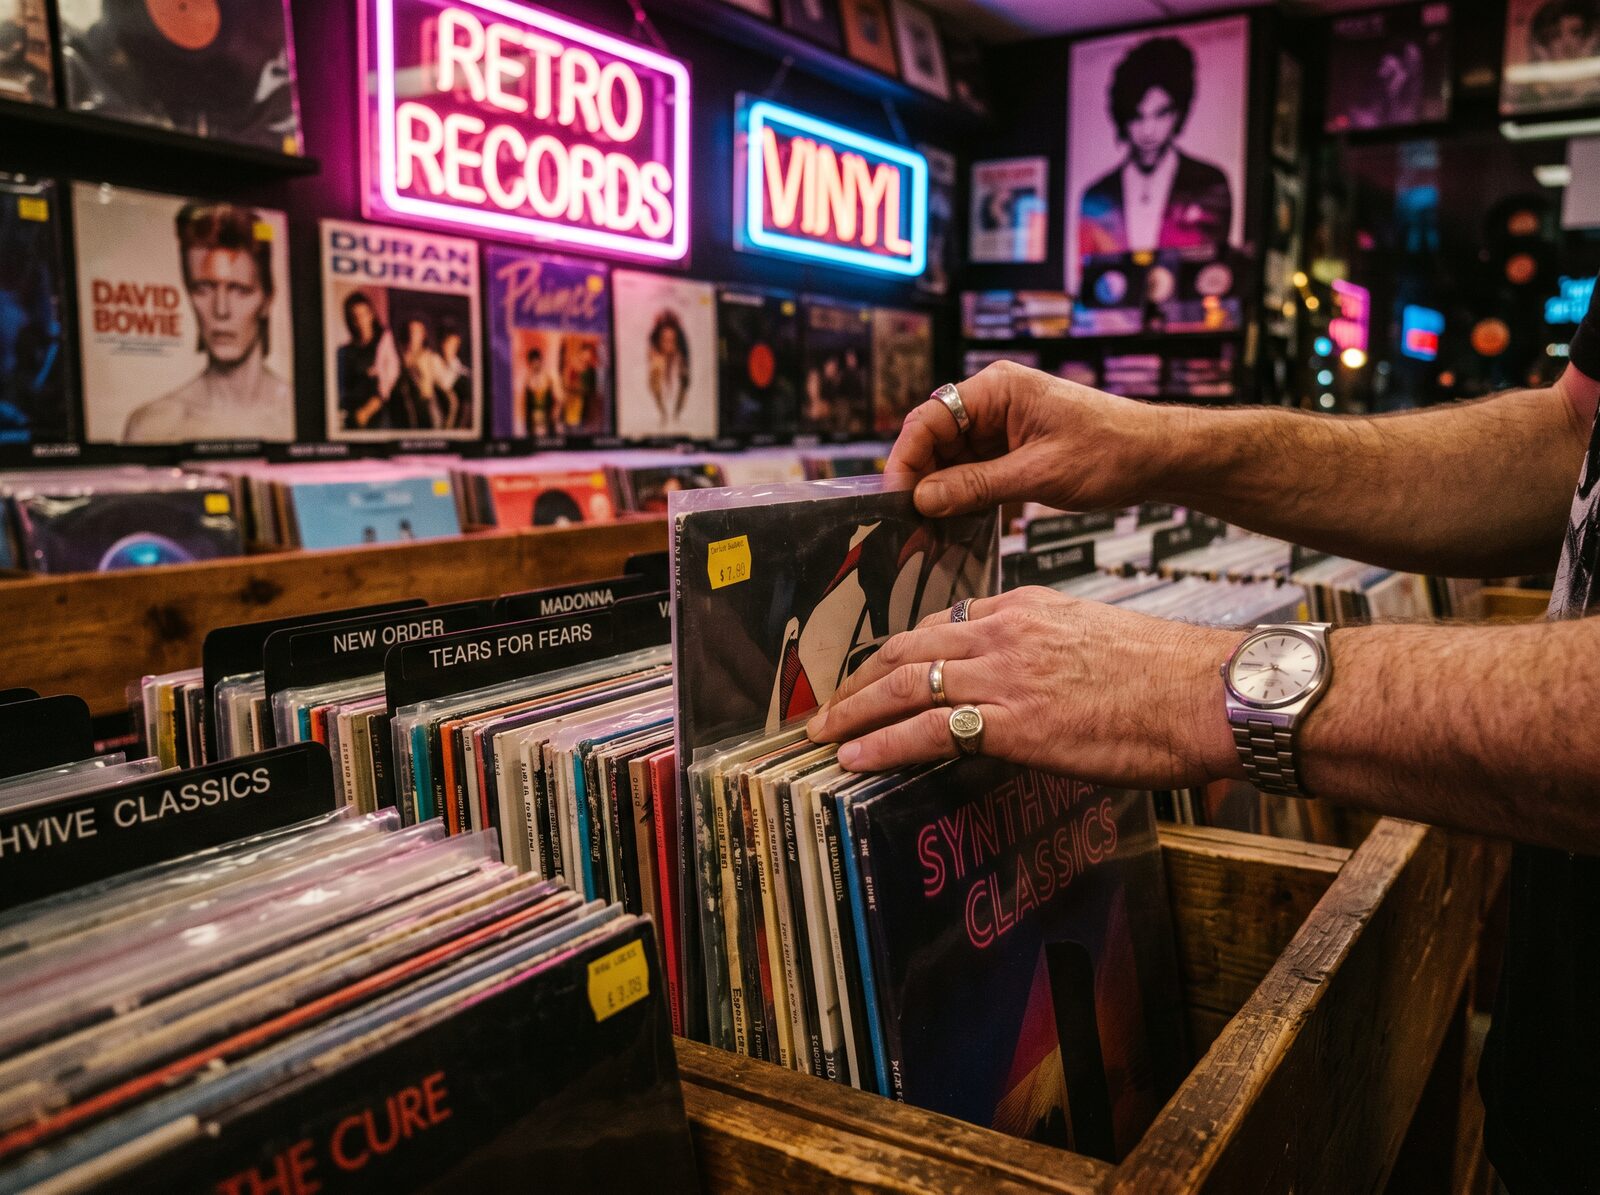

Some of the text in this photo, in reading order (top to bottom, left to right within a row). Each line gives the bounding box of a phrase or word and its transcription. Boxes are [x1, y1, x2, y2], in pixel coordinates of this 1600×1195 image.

[436, 7, 643, 142] RETRO
[394, 101, 673, 239] RECORDS
[762, 126, 912, 257] VINYL
[331, 231, 469, 265] DURAN
[332, 255, 470, 286] DURAN
[92, 280, 180, 309] DAVID
[93, 309, 183, 337] BOWIE
[540, 589, 614, 617] MADONNA
[333, 619, 444, 654] NEW ORDER
[429, 623, 592, 669] TEARS FOR FEARS
[113, 767, 270, 828] CLASSICS
[965, 798, 1118, 949] CLASSICS
[330, 1071, 453, 1171] CURE
